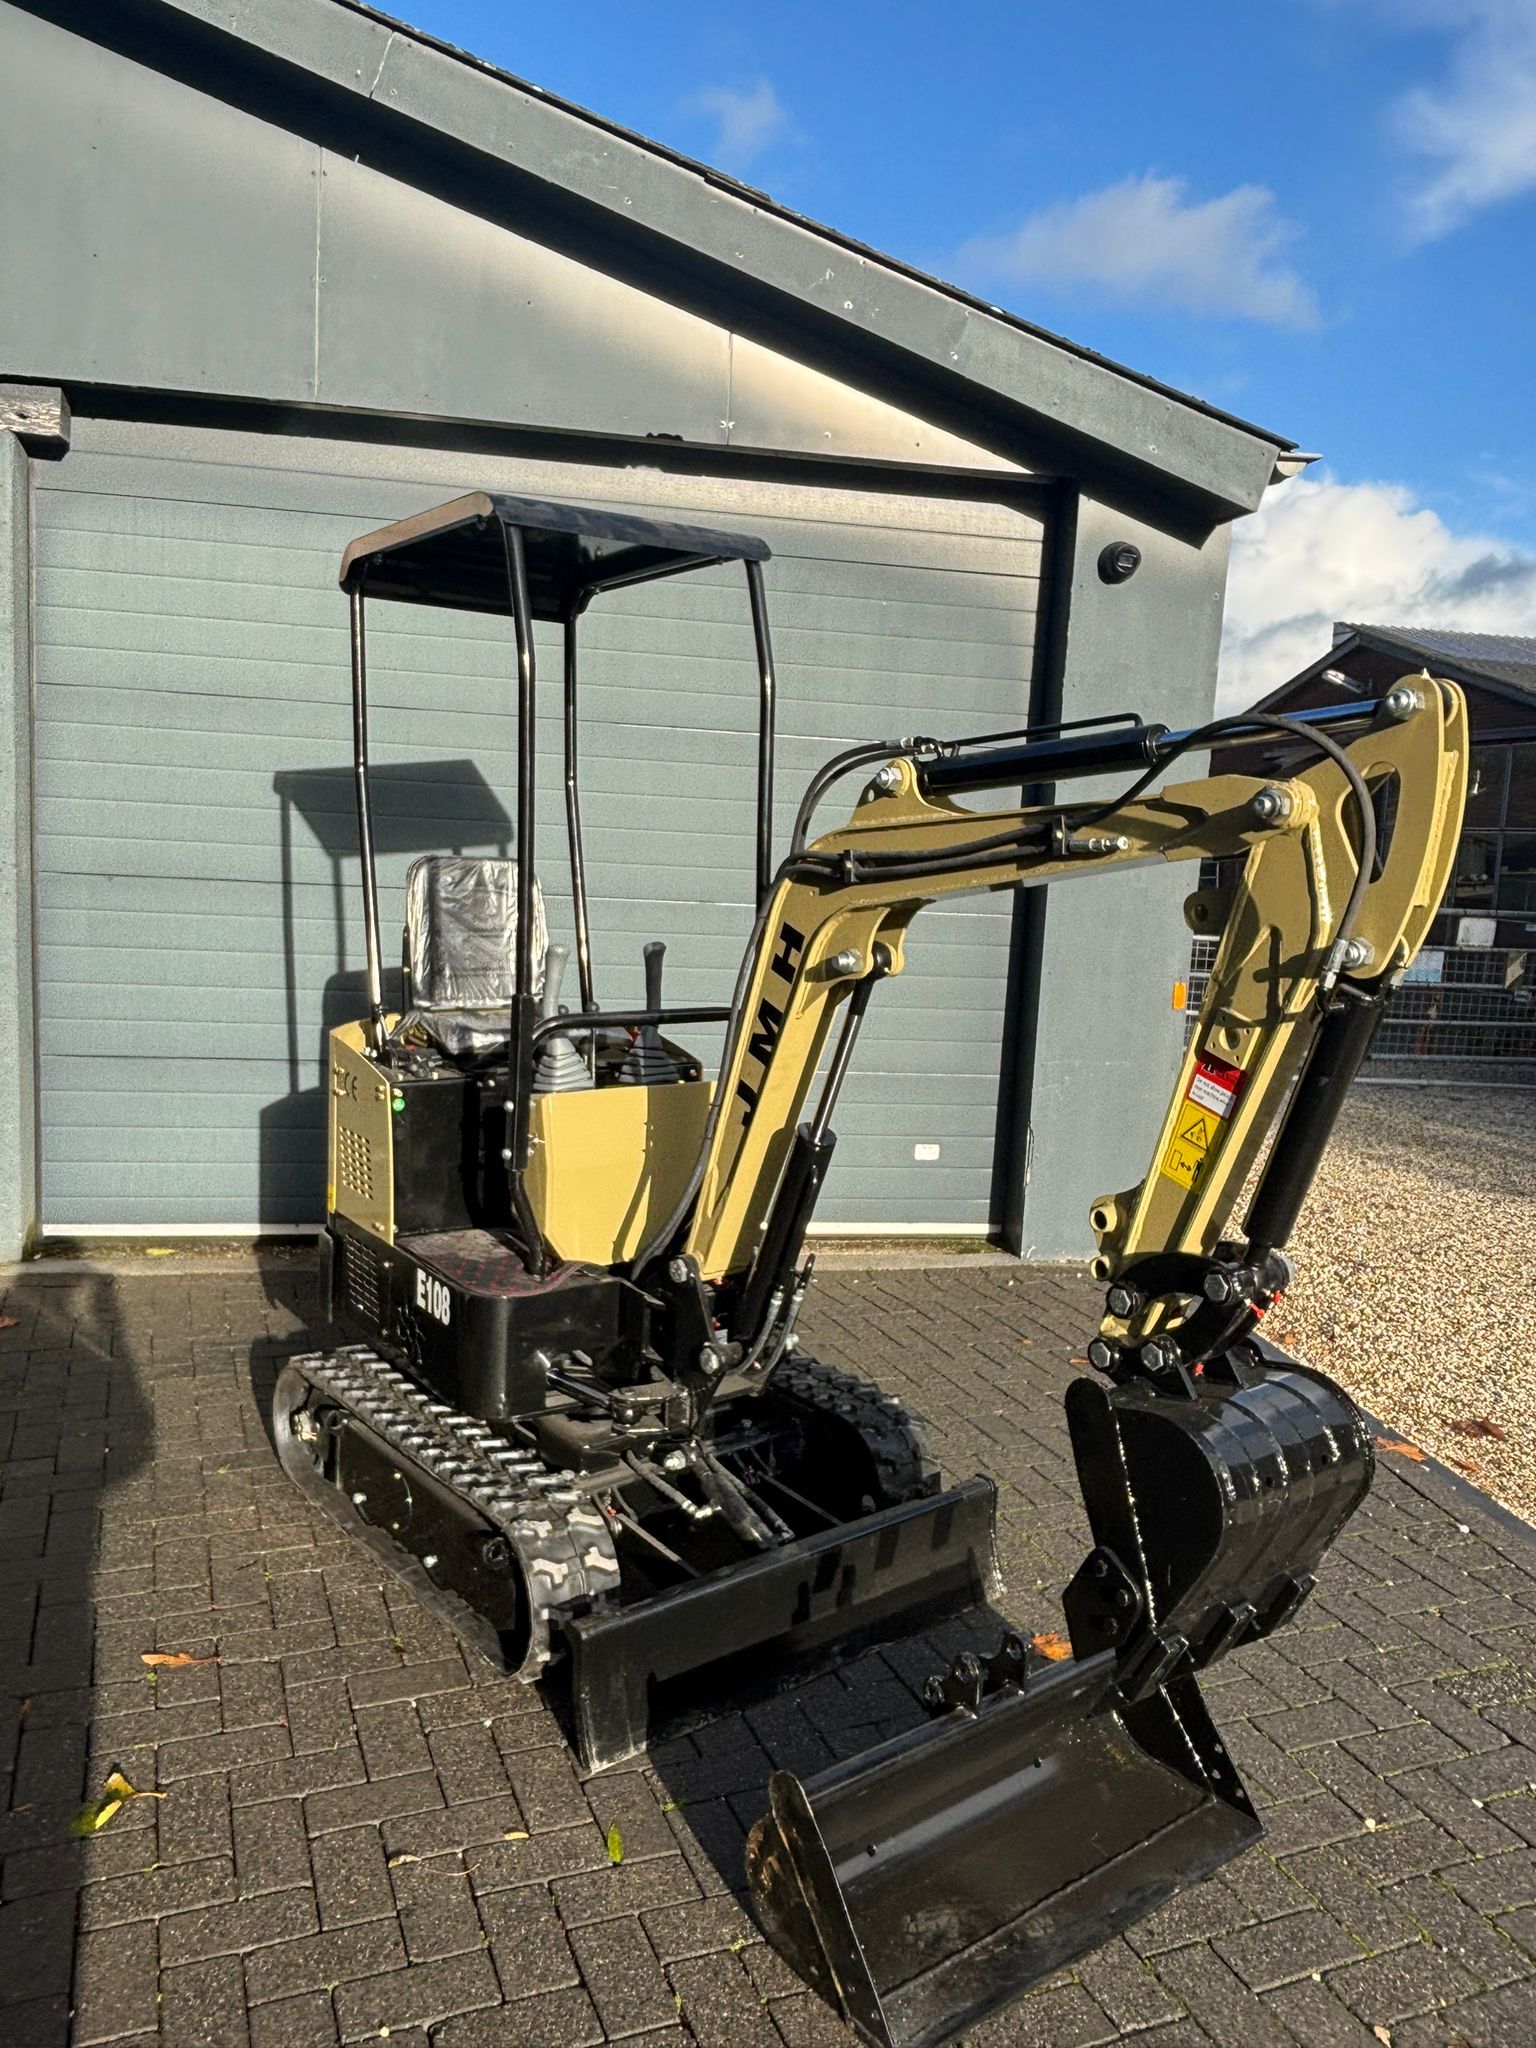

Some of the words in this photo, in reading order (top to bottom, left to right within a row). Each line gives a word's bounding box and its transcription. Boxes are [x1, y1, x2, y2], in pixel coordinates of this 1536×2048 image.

[737, 922, 805, 1127] JMH
[344, 1072, 357, 1101] CE
[417, 1268, 450, 1326] E108
